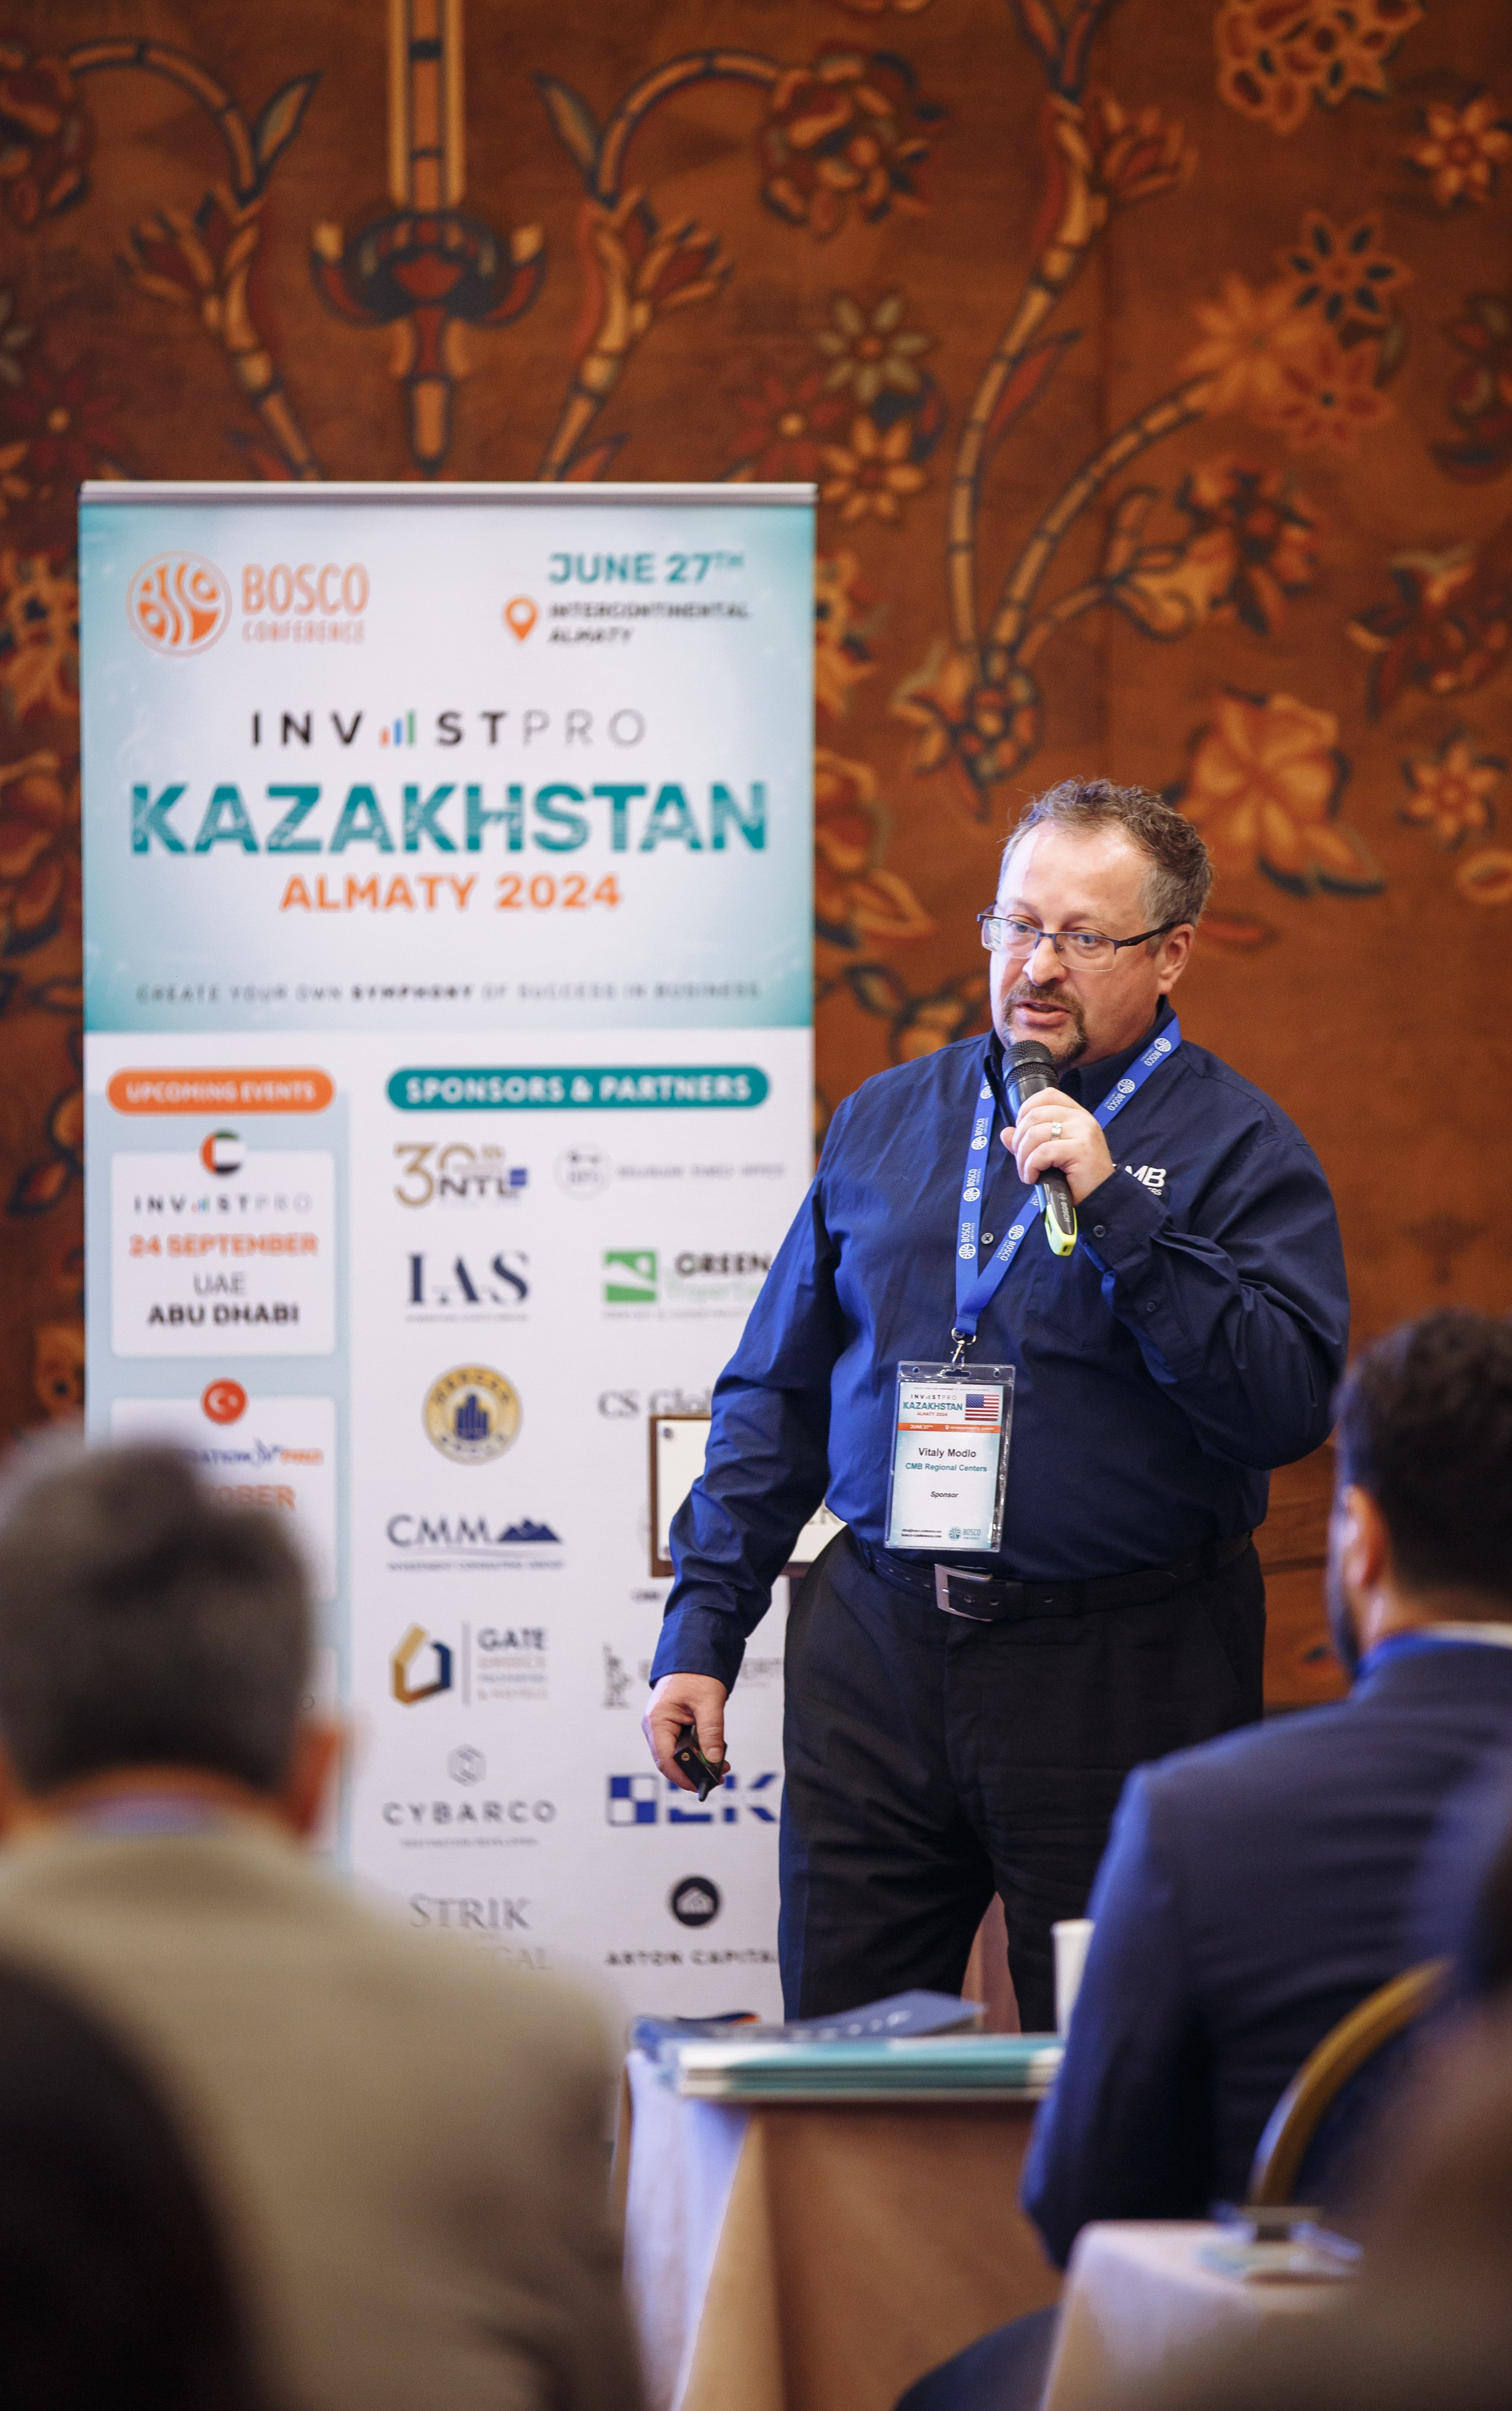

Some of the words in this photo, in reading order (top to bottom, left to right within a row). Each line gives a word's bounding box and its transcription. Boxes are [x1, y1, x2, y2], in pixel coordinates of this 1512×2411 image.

[548, 552, 656, 585] JUNE
[241, 562, 370, 616] BOSCO
[241, 620, 368, 644] CONFERENCE
[548, 626, 633, 645] ALMATY
[131, 783, 768, 856] KAZAKHSTAN
[280, 873, 479, 913] ALMATY
[494, 872, 623, 911] 2024
[351, 982, 473, 1002] SYMPHONY
[1143, 1050, 1162, 1066] BOSCO
[126, 1081, 235, 1103] UPCOMING
[240, 1080, 317, 1101] EVENTS
[406, 1076, 565, 1104] SPONSORS
[571, 1077, 592, 1102] &
[600, 1074, 752, 1102] PARTNERS
[1107, 1093, 1126, 1111] BOSCO
[975, 1118, 985, 1136] BOSCO
[967, 1169, 977, 1187] BOSCO
[1112, 1164, 1166, 1187] MB
[1061, 1202, 1071, 1223] BOSCH
[129, 1234, 162, 1257] 24
[167, 1233, 319, 1257] SEPTEMBER
[961, 1223, 970, 1243] BOSCO
[1000, 1241, 1016, 1261] BOSCO
[676, 1252, 771, 1277] GREEN
[193, 1270, 247, 1296] UAE
[408, 1250, 530, 1305] IAS
[148, 1303, 206, 1326] ABU
[213, 1302, 299, 1325] DHABI
[598, 1389, 640, 1419] CS
[650, 1387, 712, 1413] Glo
[903, 1402, 963, 1410] KAZAKHSTAN
[918, 1448, 944, 1458] Vitaly
[947, 1449, 976, 1458] Modlo
[925, 1463, 957, 1471] Regional
[387, 1513, 491, 1548] CMM
[478, 1627, 548, 1651] GATE
[383, 1801, 557, 1825] CYBARCO
[410, 1892, 533, 1930] STRIK
